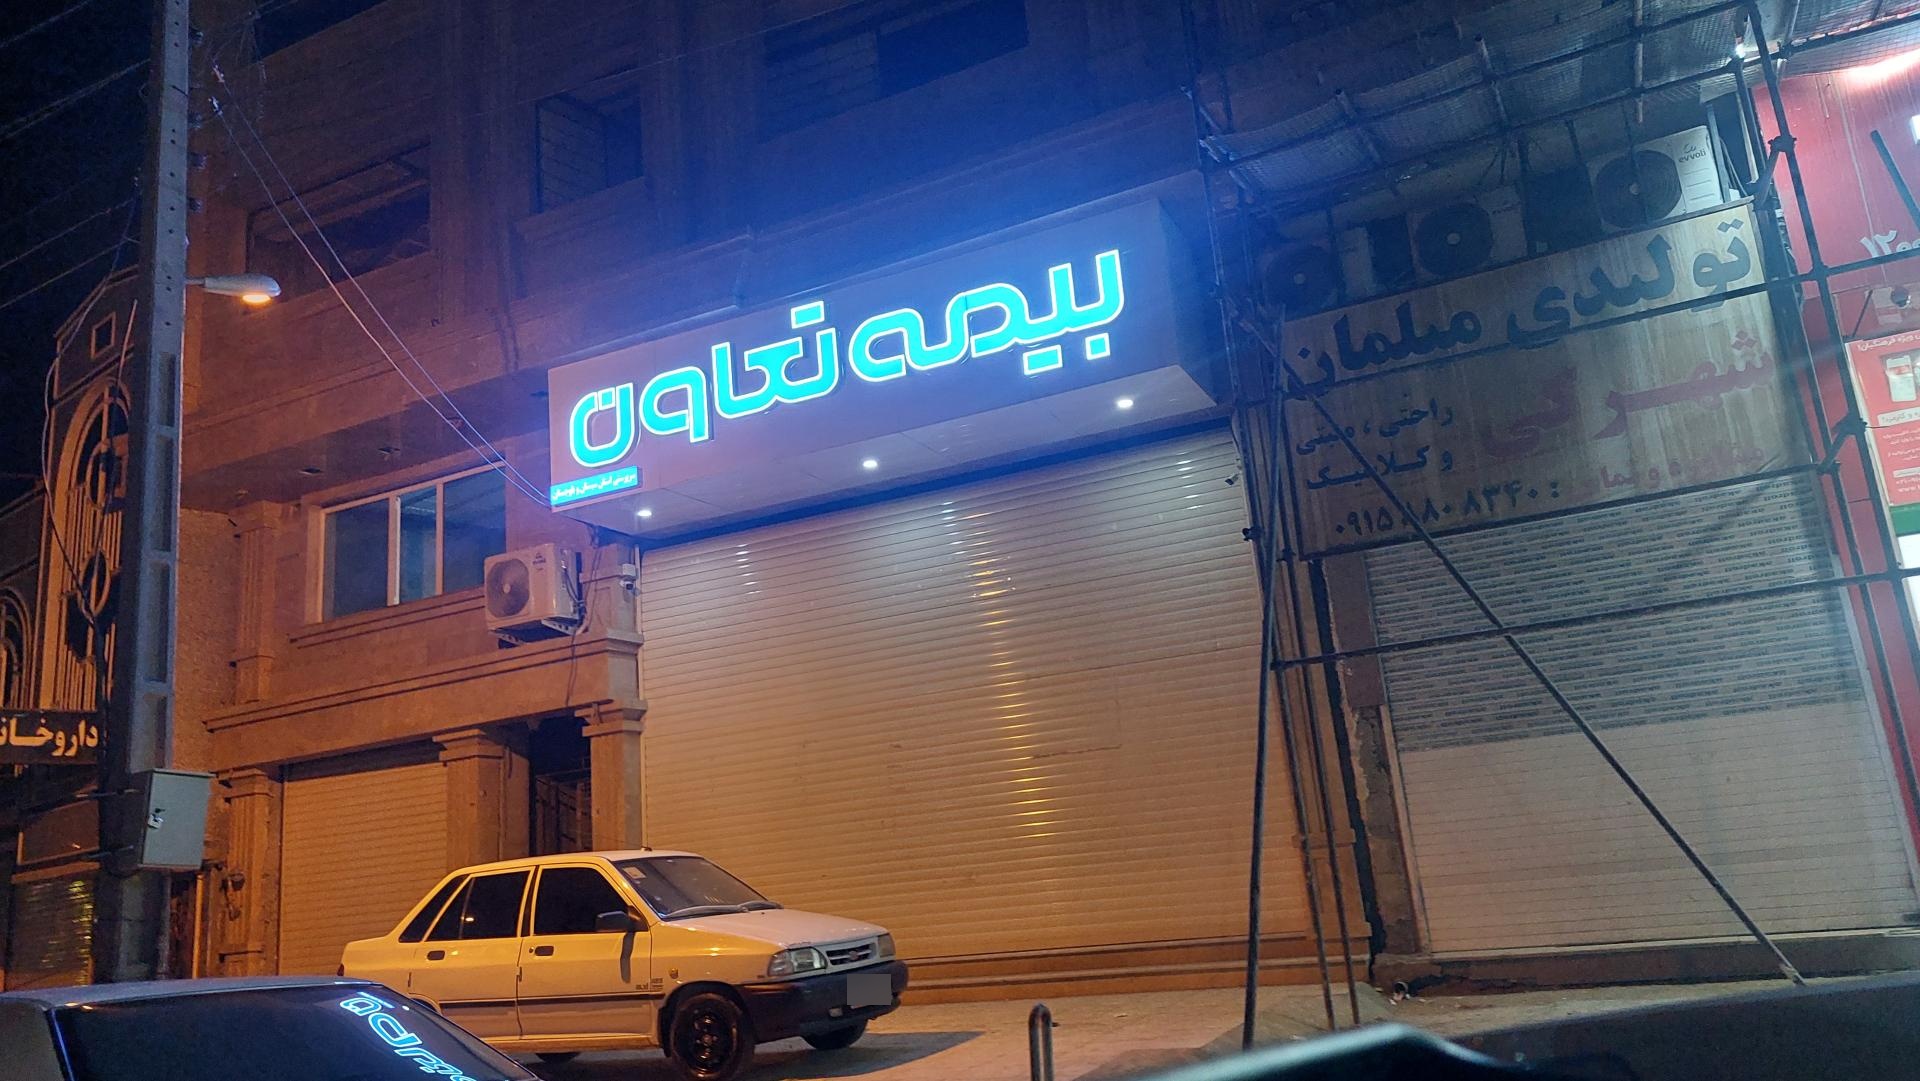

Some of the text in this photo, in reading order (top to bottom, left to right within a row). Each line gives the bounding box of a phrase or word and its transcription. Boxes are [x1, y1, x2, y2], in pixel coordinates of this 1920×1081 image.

[1679, 149, 1706, 163] evvoli
[569, 249, 1125, 468] بیمه تعاون
